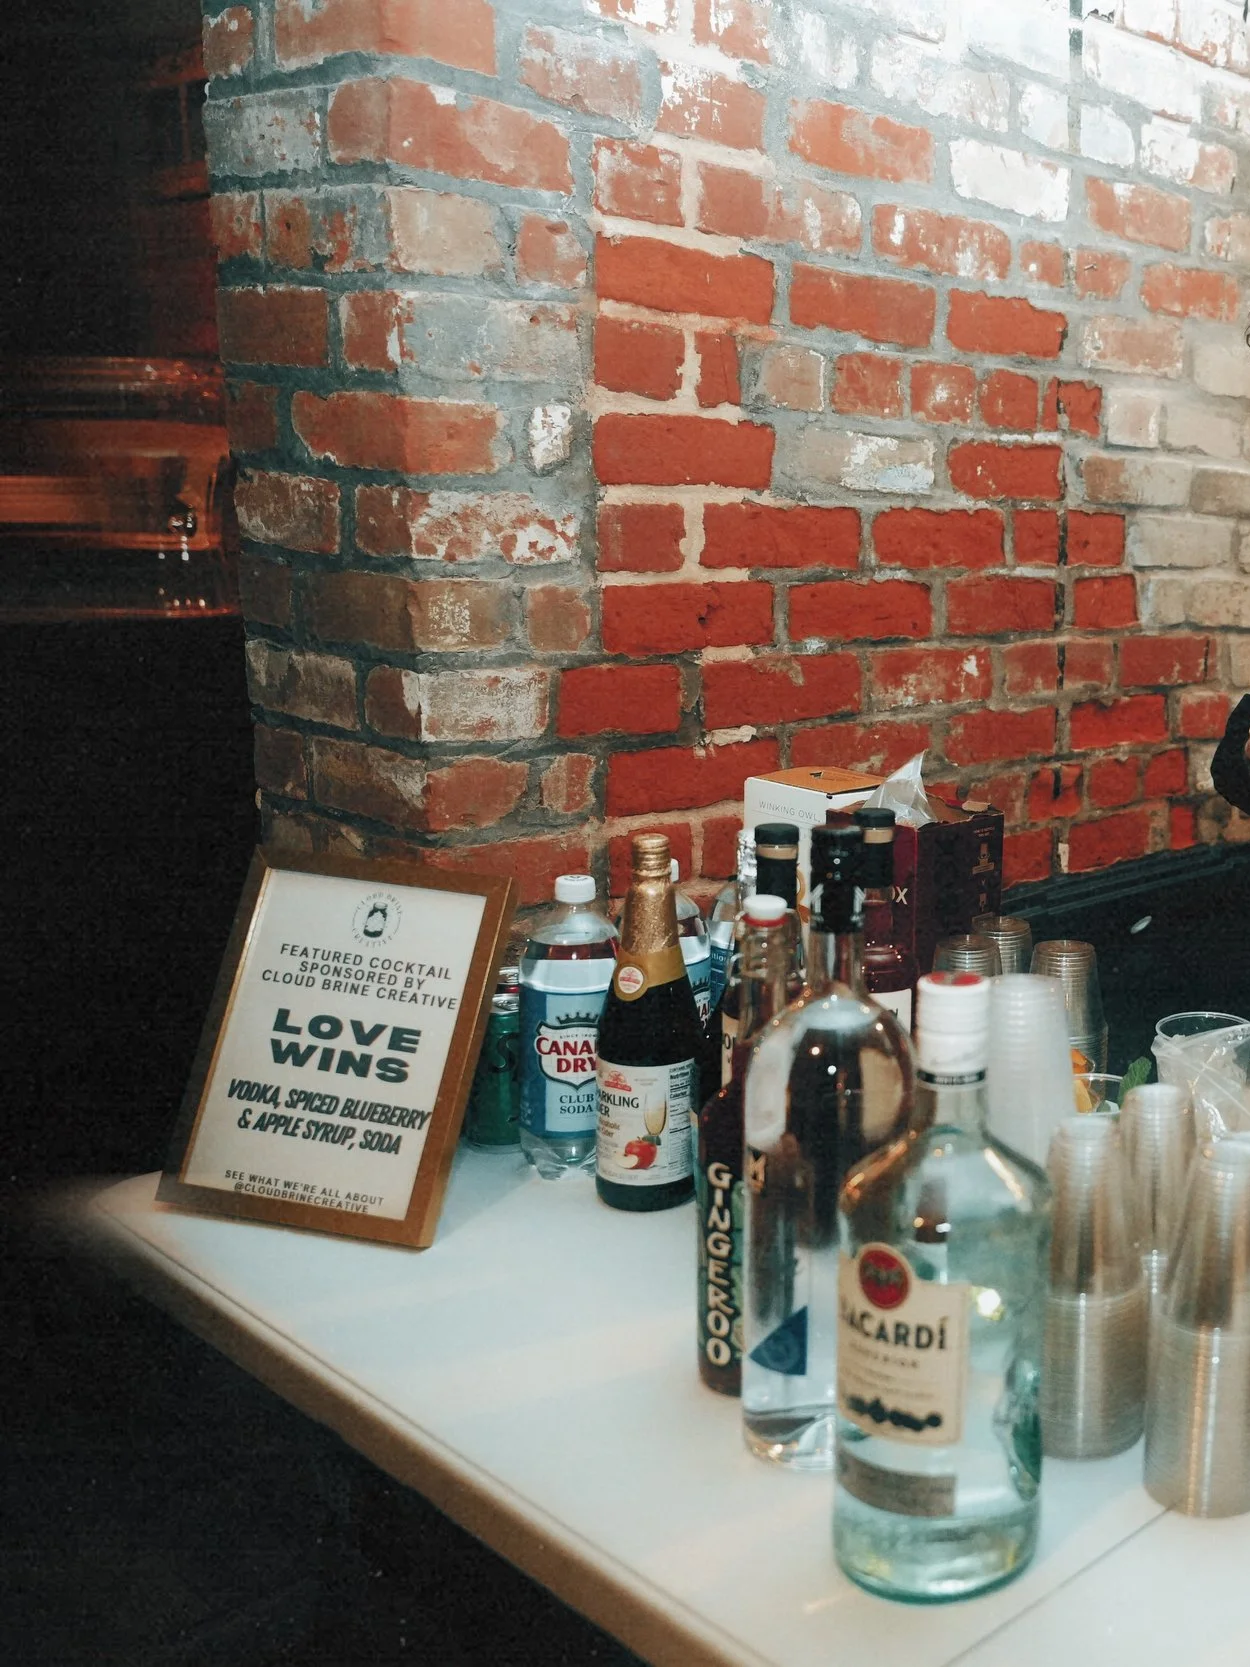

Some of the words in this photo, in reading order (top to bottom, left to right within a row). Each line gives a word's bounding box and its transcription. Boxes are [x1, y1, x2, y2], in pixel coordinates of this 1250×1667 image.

[758, 800, 795, 816] WINKING
[280, 943, 363, 966] FEATURED
[369, 957, 452, 980] COCKTAIL
[300, 960, 397, 986] SPONSORED
[404, 976, 425, 991] BY
[262, 969, 316, 988] CLOUD
[321, 978, 369, 997] BRINE
[376, 987, 458, 1010] CREATIVE
[272, 1008, 422, 1054] LOVE
[536, 1036, 598, 1056] CANA
[270, 1038, 410, 1083] WINS
[556, 1057, 597, 1073] DRY
[227, 1078, 282, 1110] VODKA,
[284, 1088, 340, 1116] SPICED
[339, 1097, 432, 1130] BLUEBERRY
[559, 1093, 595, 1104] CLUB
[559, 1104, 594, 1115] SODA
[237, 1108, 252, 1129] &
[252, 1112, 304, 1137] APPLE
[302, 1119, 356, 1150] SYRUP,
[359, 1129, 403, 1155] SODA
[224, 1169, 245, 1181] SEE
[249, 1174, 279, 1187] WHAT
[283, 1180, 317, 1194] WE'RE
[320, 1187, 341, 1199] ALL
[345, 1191, 385, 1206] ABOUT
[234, 1181, 370, 1214] @CLOUDBRINECREATIVE
[706, 1162, 735, 1367] GINGEROO
